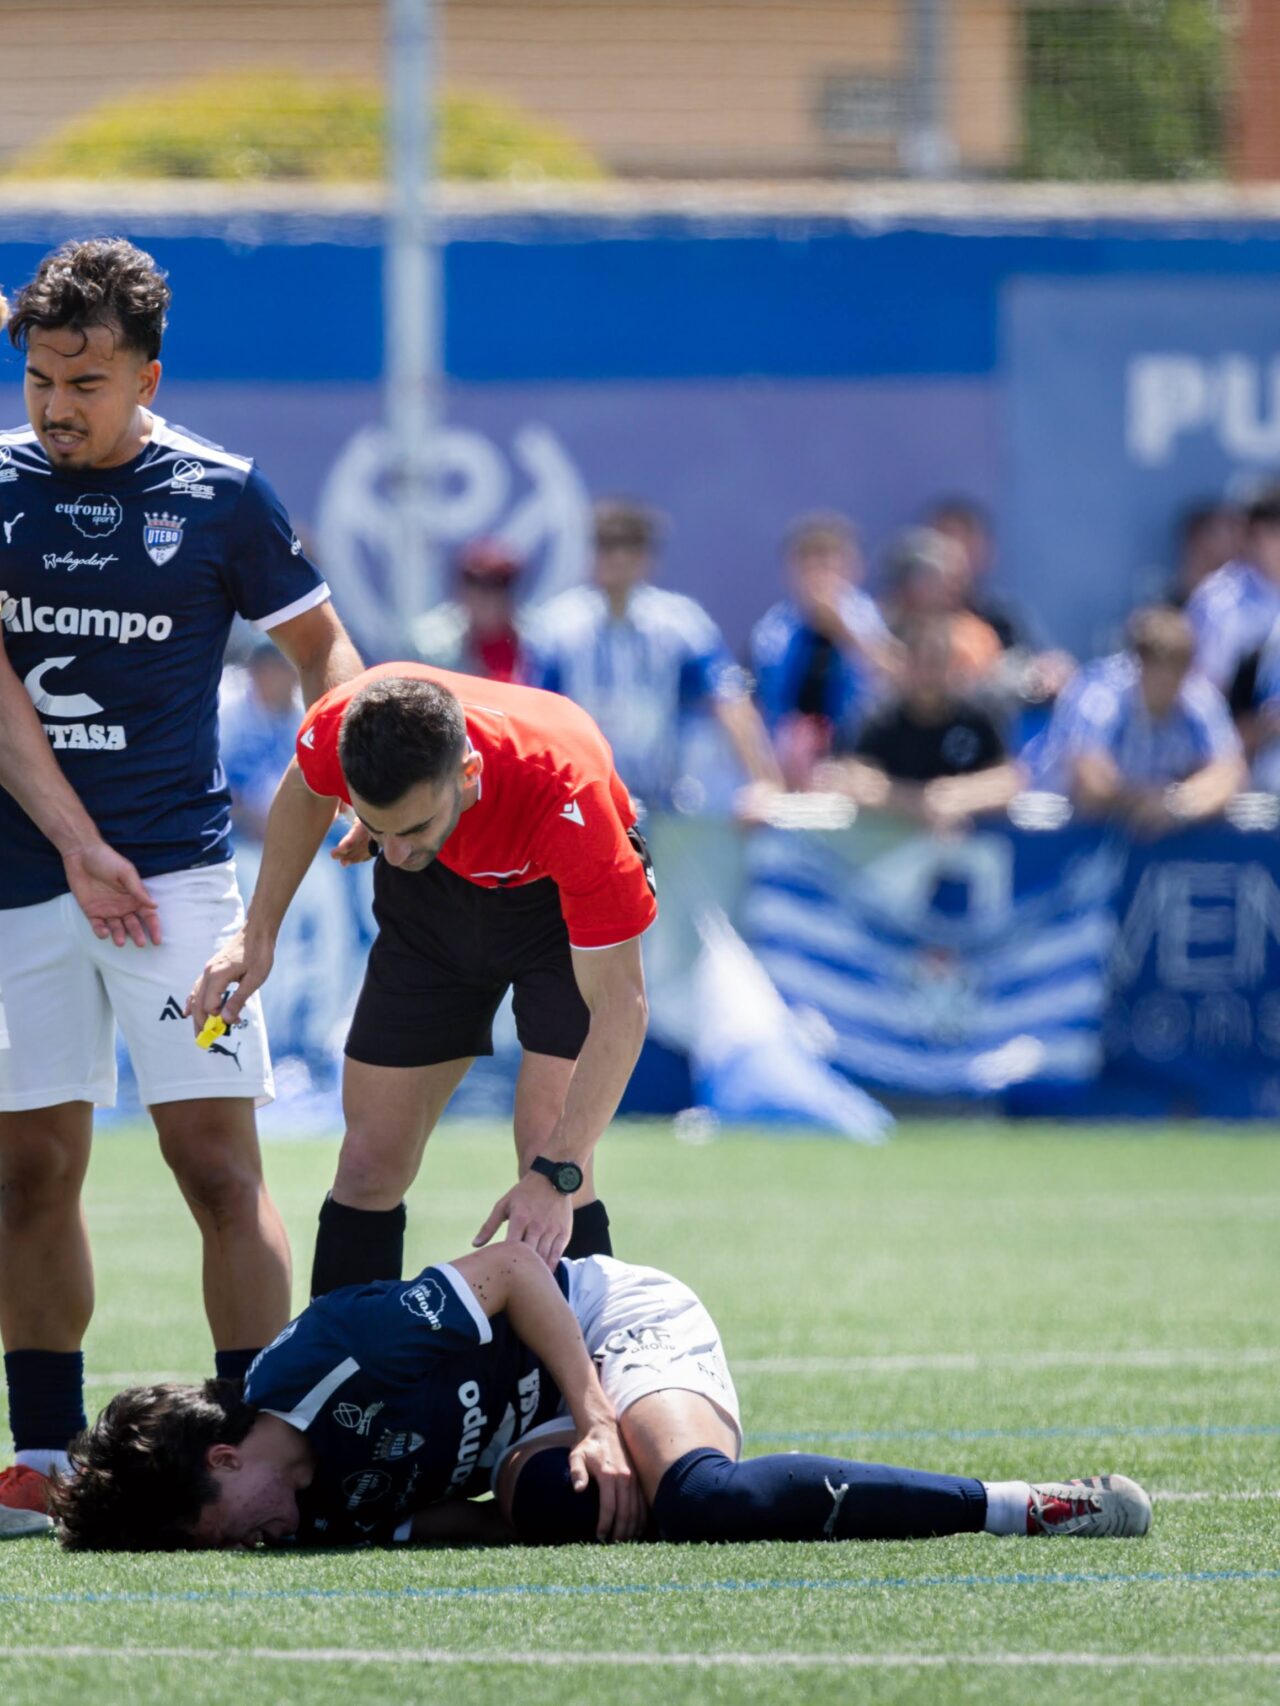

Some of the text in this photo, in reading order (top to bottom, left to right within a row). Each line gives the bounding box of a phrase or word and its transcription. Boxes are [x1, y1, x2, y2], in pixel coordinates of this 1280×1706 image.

[54, 502, 117, 516] euronix
[147, 528, 179, 545] UTEBO
[42, 723, 128, 750] TASA
